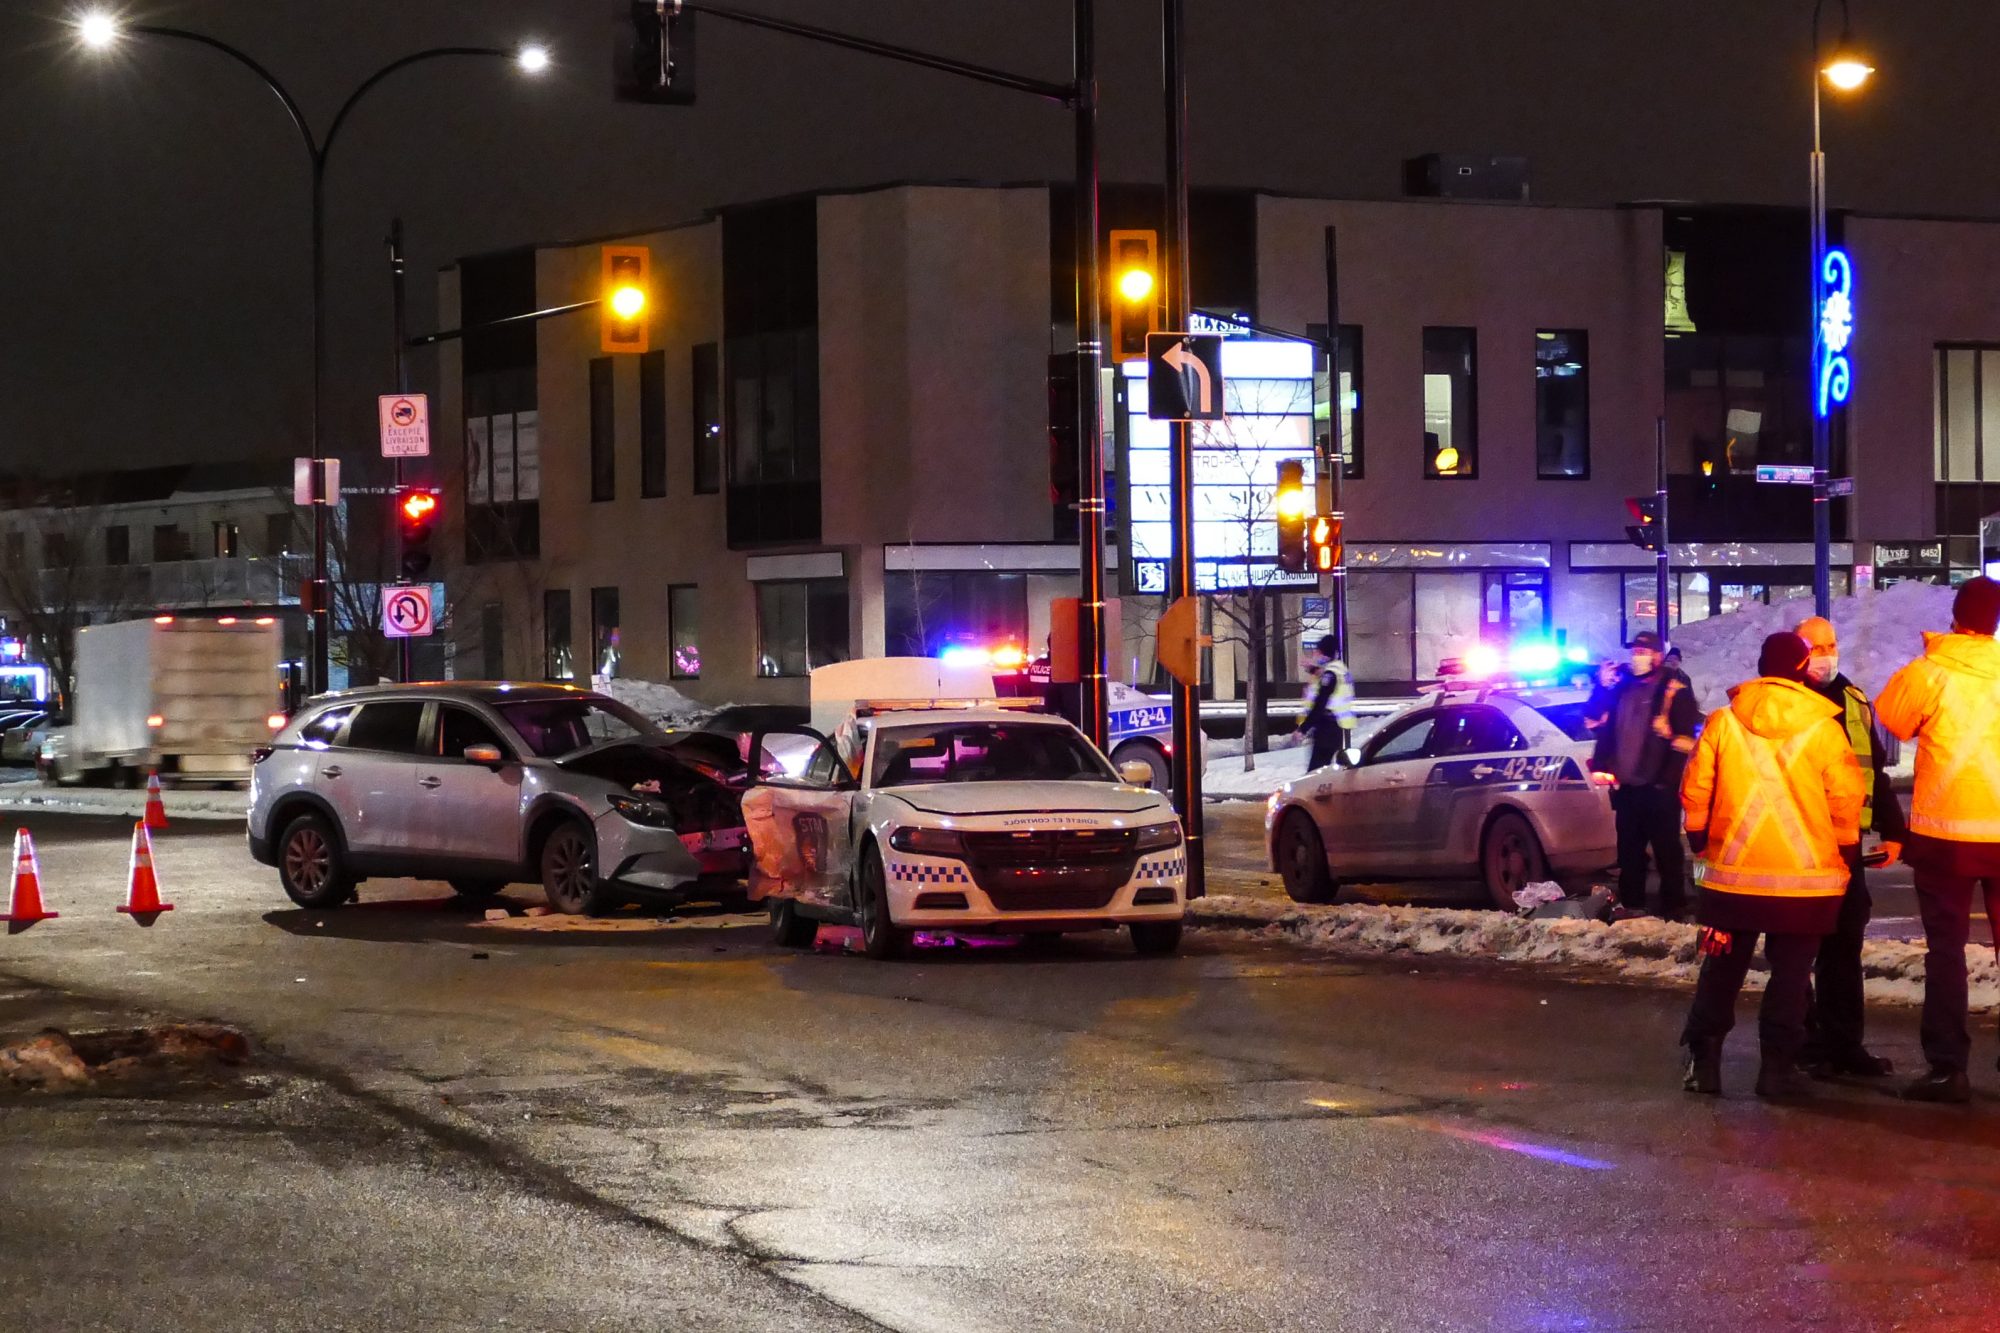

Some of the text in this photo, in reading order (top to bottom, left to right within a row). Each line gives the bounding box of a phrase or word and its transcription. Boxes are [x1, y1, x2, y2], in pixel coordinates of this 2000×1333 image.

[1920, 549, 1939, 558] 6452
[1030, 665, 1051, 675] POLICE
[1128, 707, 1167, 727] 42-4
[1502, 757, 1546, 780] 42-8
[799, 818, 824, 832] STM
